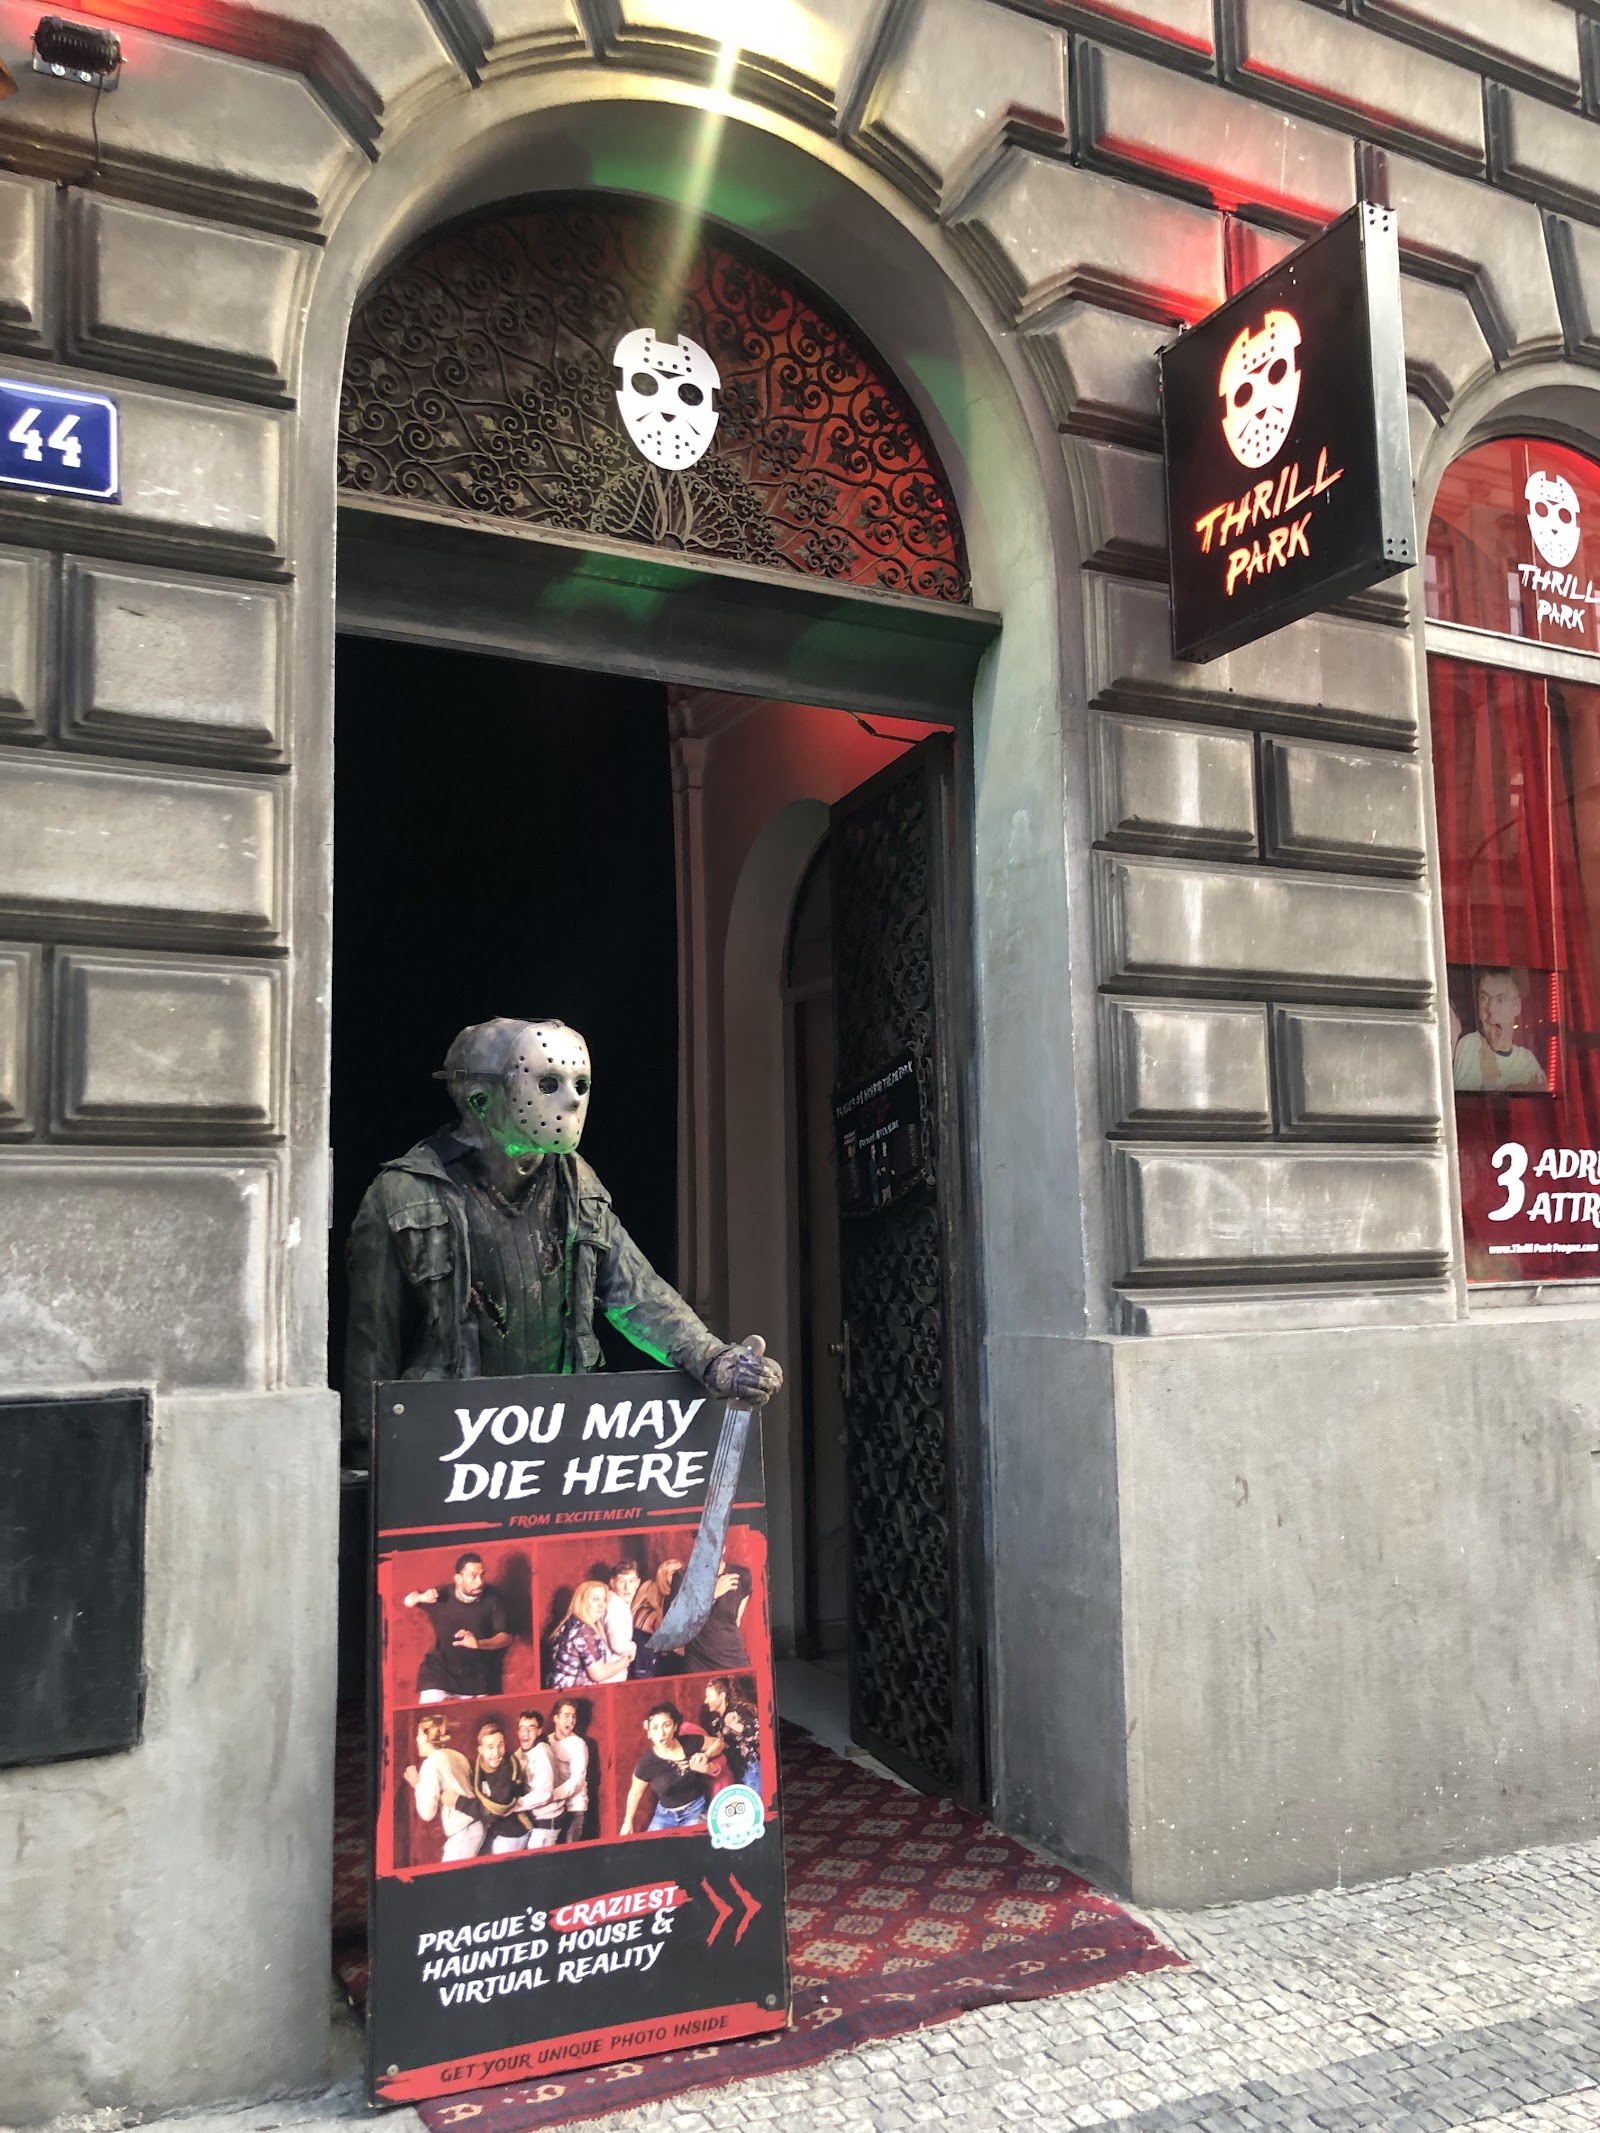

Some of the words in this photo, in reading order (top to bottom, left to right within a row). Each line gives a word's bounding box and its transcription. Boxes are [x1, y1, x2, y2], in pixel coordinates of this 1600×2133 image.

[9, 407, 82, 468] 44
[1195, 446, 1345, 553] THRILL
[1226, 512, 1312, 596] PARK
[1518, 563, 1600, 604] THRILL
[1537, 599, 1586, 634] PARK
[1488, 1142, 1528, 1222] 3
[1532, 1148, 1600, 1186] ADR
[438, 1402, 565, 1462] YOU
[582, 1397, 707, 1450] MAY
[444, 1459, 546, 1503] DIE
[562, 1450, 709, 1498] HERE
[509, 1512, 552, 1529] FROM
[554, 1506, 643, 1525] EXCITEMENT
[416, 1907, 548, 1956] PRAGUE'S
[555, 1885, 680, 1928] CRAZIEST
[422, 1937, 549, 1983] HAUNTED
[557, 1920, 643, 1955] HOUSE
[651, 1906, 677, 1937] &
[439, 1974, 551, 2008] VIRTUAL
[556, 1942, 666, 1984] REALITY
[440, 2064, 478, 2084] GET
[477, 2052, 534, 2081] YOUR
[537, 2039, 604, 2065] UNIQUE
[610, 2027, 668, 2050] PHOTO
[673, 2014, 730, 2038] INSIDE
